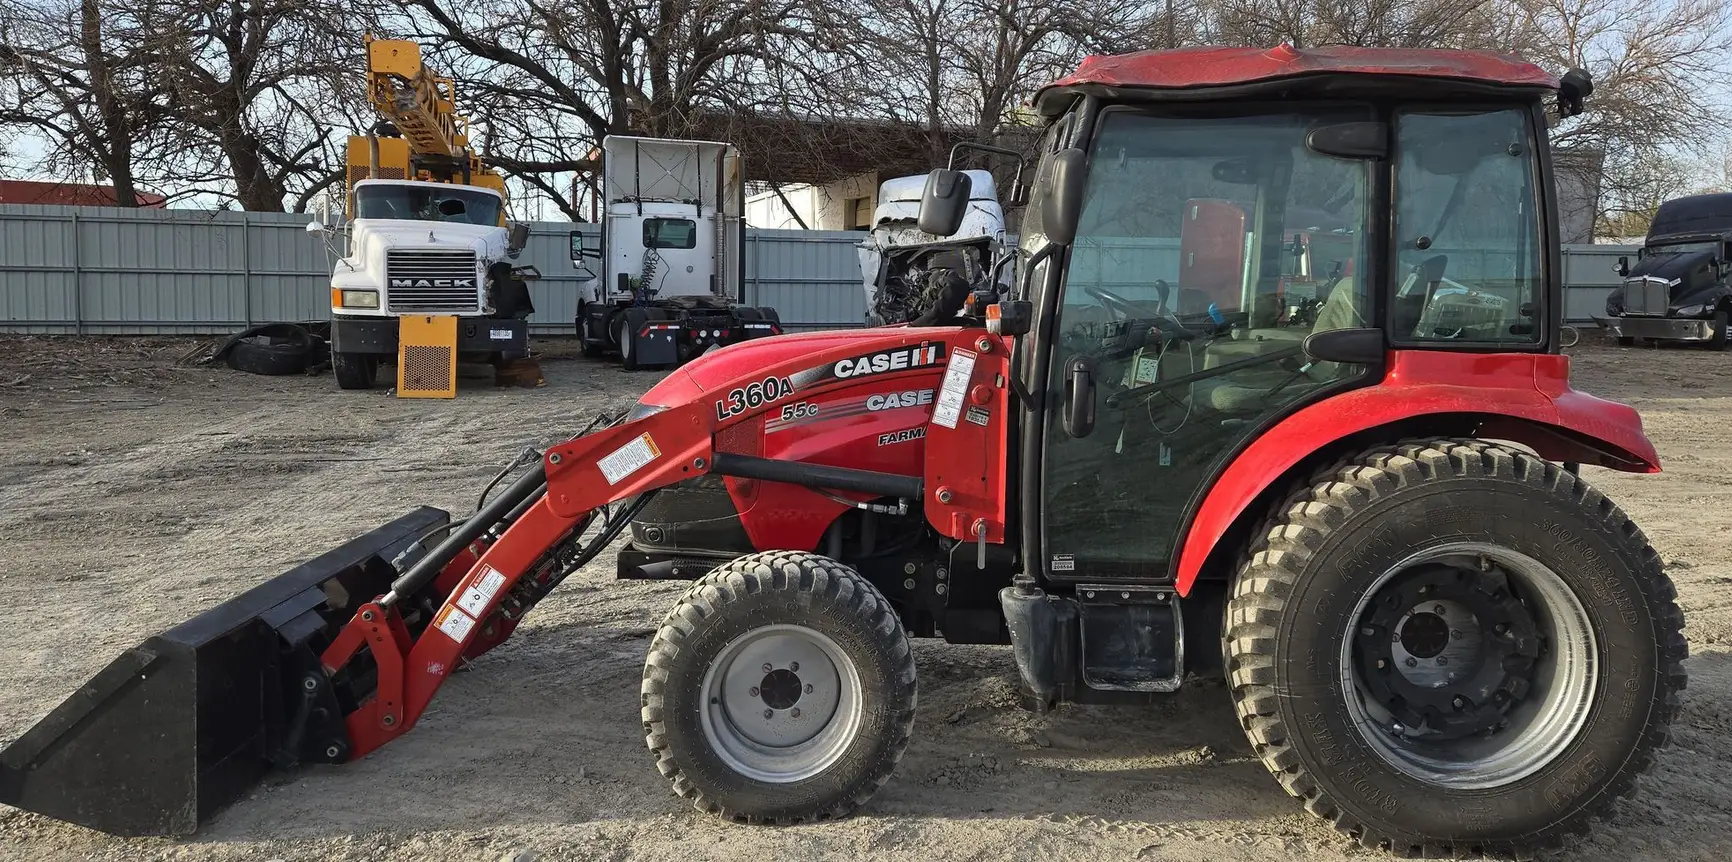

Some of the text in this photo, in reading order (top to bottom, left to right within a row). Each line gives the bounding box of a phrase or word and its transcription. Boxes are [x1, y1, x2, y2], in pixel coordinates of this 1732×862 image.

[391, 279, 473, 287] MACK
[833, 351, 908, 379] CASE
[715, 376, 795, 422] L360A
[866, 389, 933, 411] CASE
